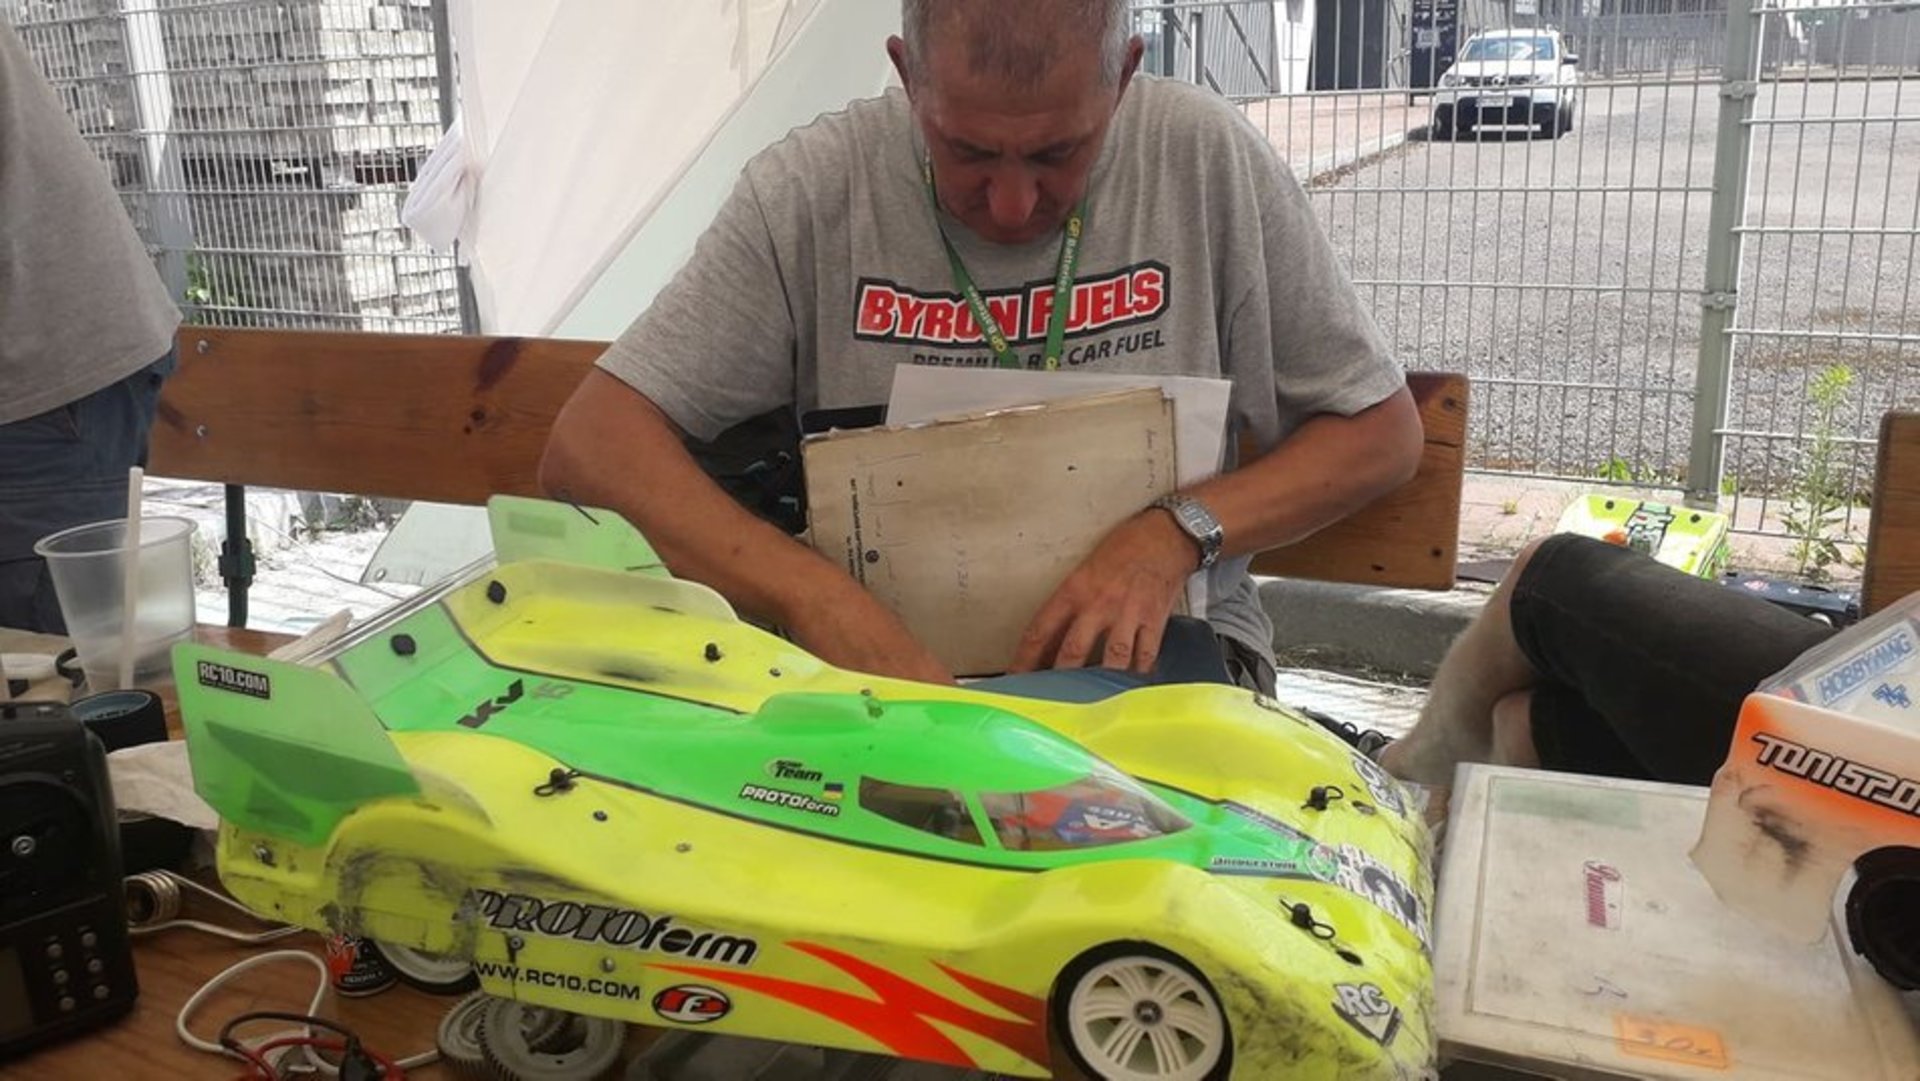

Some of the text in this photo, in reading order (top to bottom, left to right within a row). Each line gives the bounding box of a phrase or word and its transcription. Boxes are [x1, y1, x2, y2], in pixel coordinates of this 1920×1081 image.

[857, 267, 1165, 343] BYRON FUELS
[1068, 340, 1112, 366] CAR
[1114, 329, 1166, 357] FUEL
[199, 662, 268, 692] RC10.COM
[1752, 732, 1920, 817] TONISPO
[741, 784, 839, 815] PROTOform
[474, 889, 758, 966] PROTOform
[470, 960, 641, 1001] WW.RC10.COM
[1333, 981, 1391, 1017] RC
